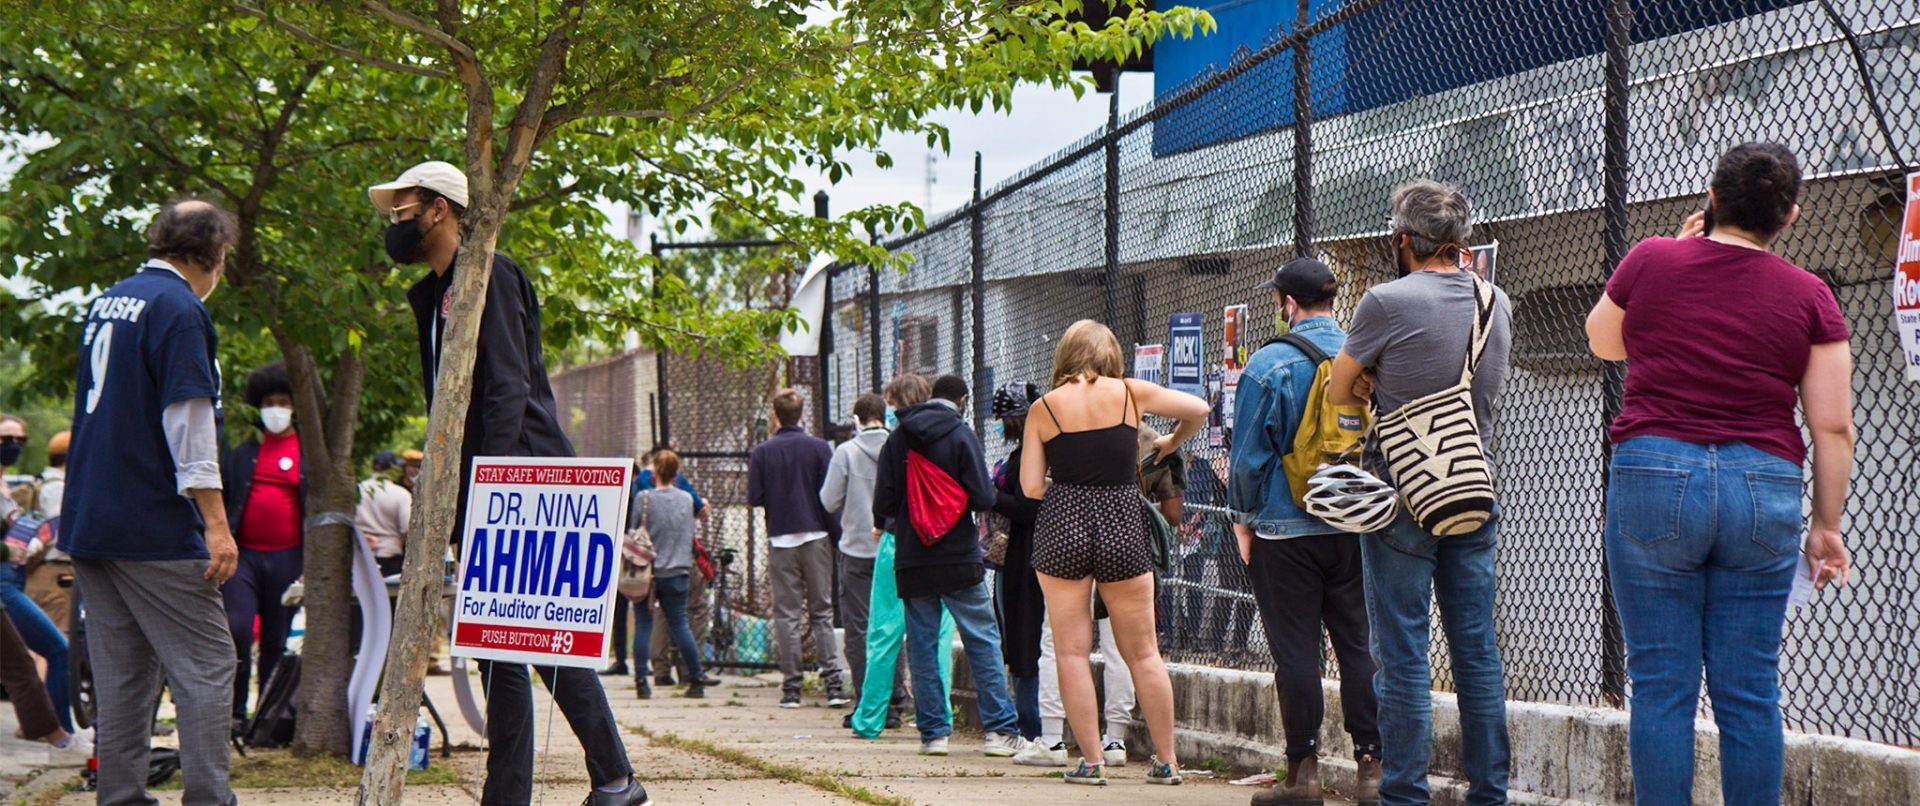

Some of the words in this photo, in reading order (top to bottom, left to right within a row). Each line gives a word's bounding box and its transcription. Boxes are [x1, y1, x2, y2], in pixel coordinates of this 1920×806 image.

[1898, 271, 1920, 306] Ro
[88, 297, 146, 323] PUSH
[1174, 335, 1199, 364] RICK!
[478, 468, 505, 482] STAY
[506, 469, 533, 483] SAFE
[535, 469, 572, 484] WHILE
[574, 469, 621, 485] VOTING
[487, 492, 526, 526] DR.
[535, 493, 600, 529] NINA
[462, 528, 614, 599] AHMAD
[462, 596, 485, 616] For
[488, 598, 541, 620] Auditor
[544, 602, 603, 625] General
[481, 629, 507, 644] PUSH
[508, 632, 550, 648] BUTTON
[551, 631, 574, 654] #9
